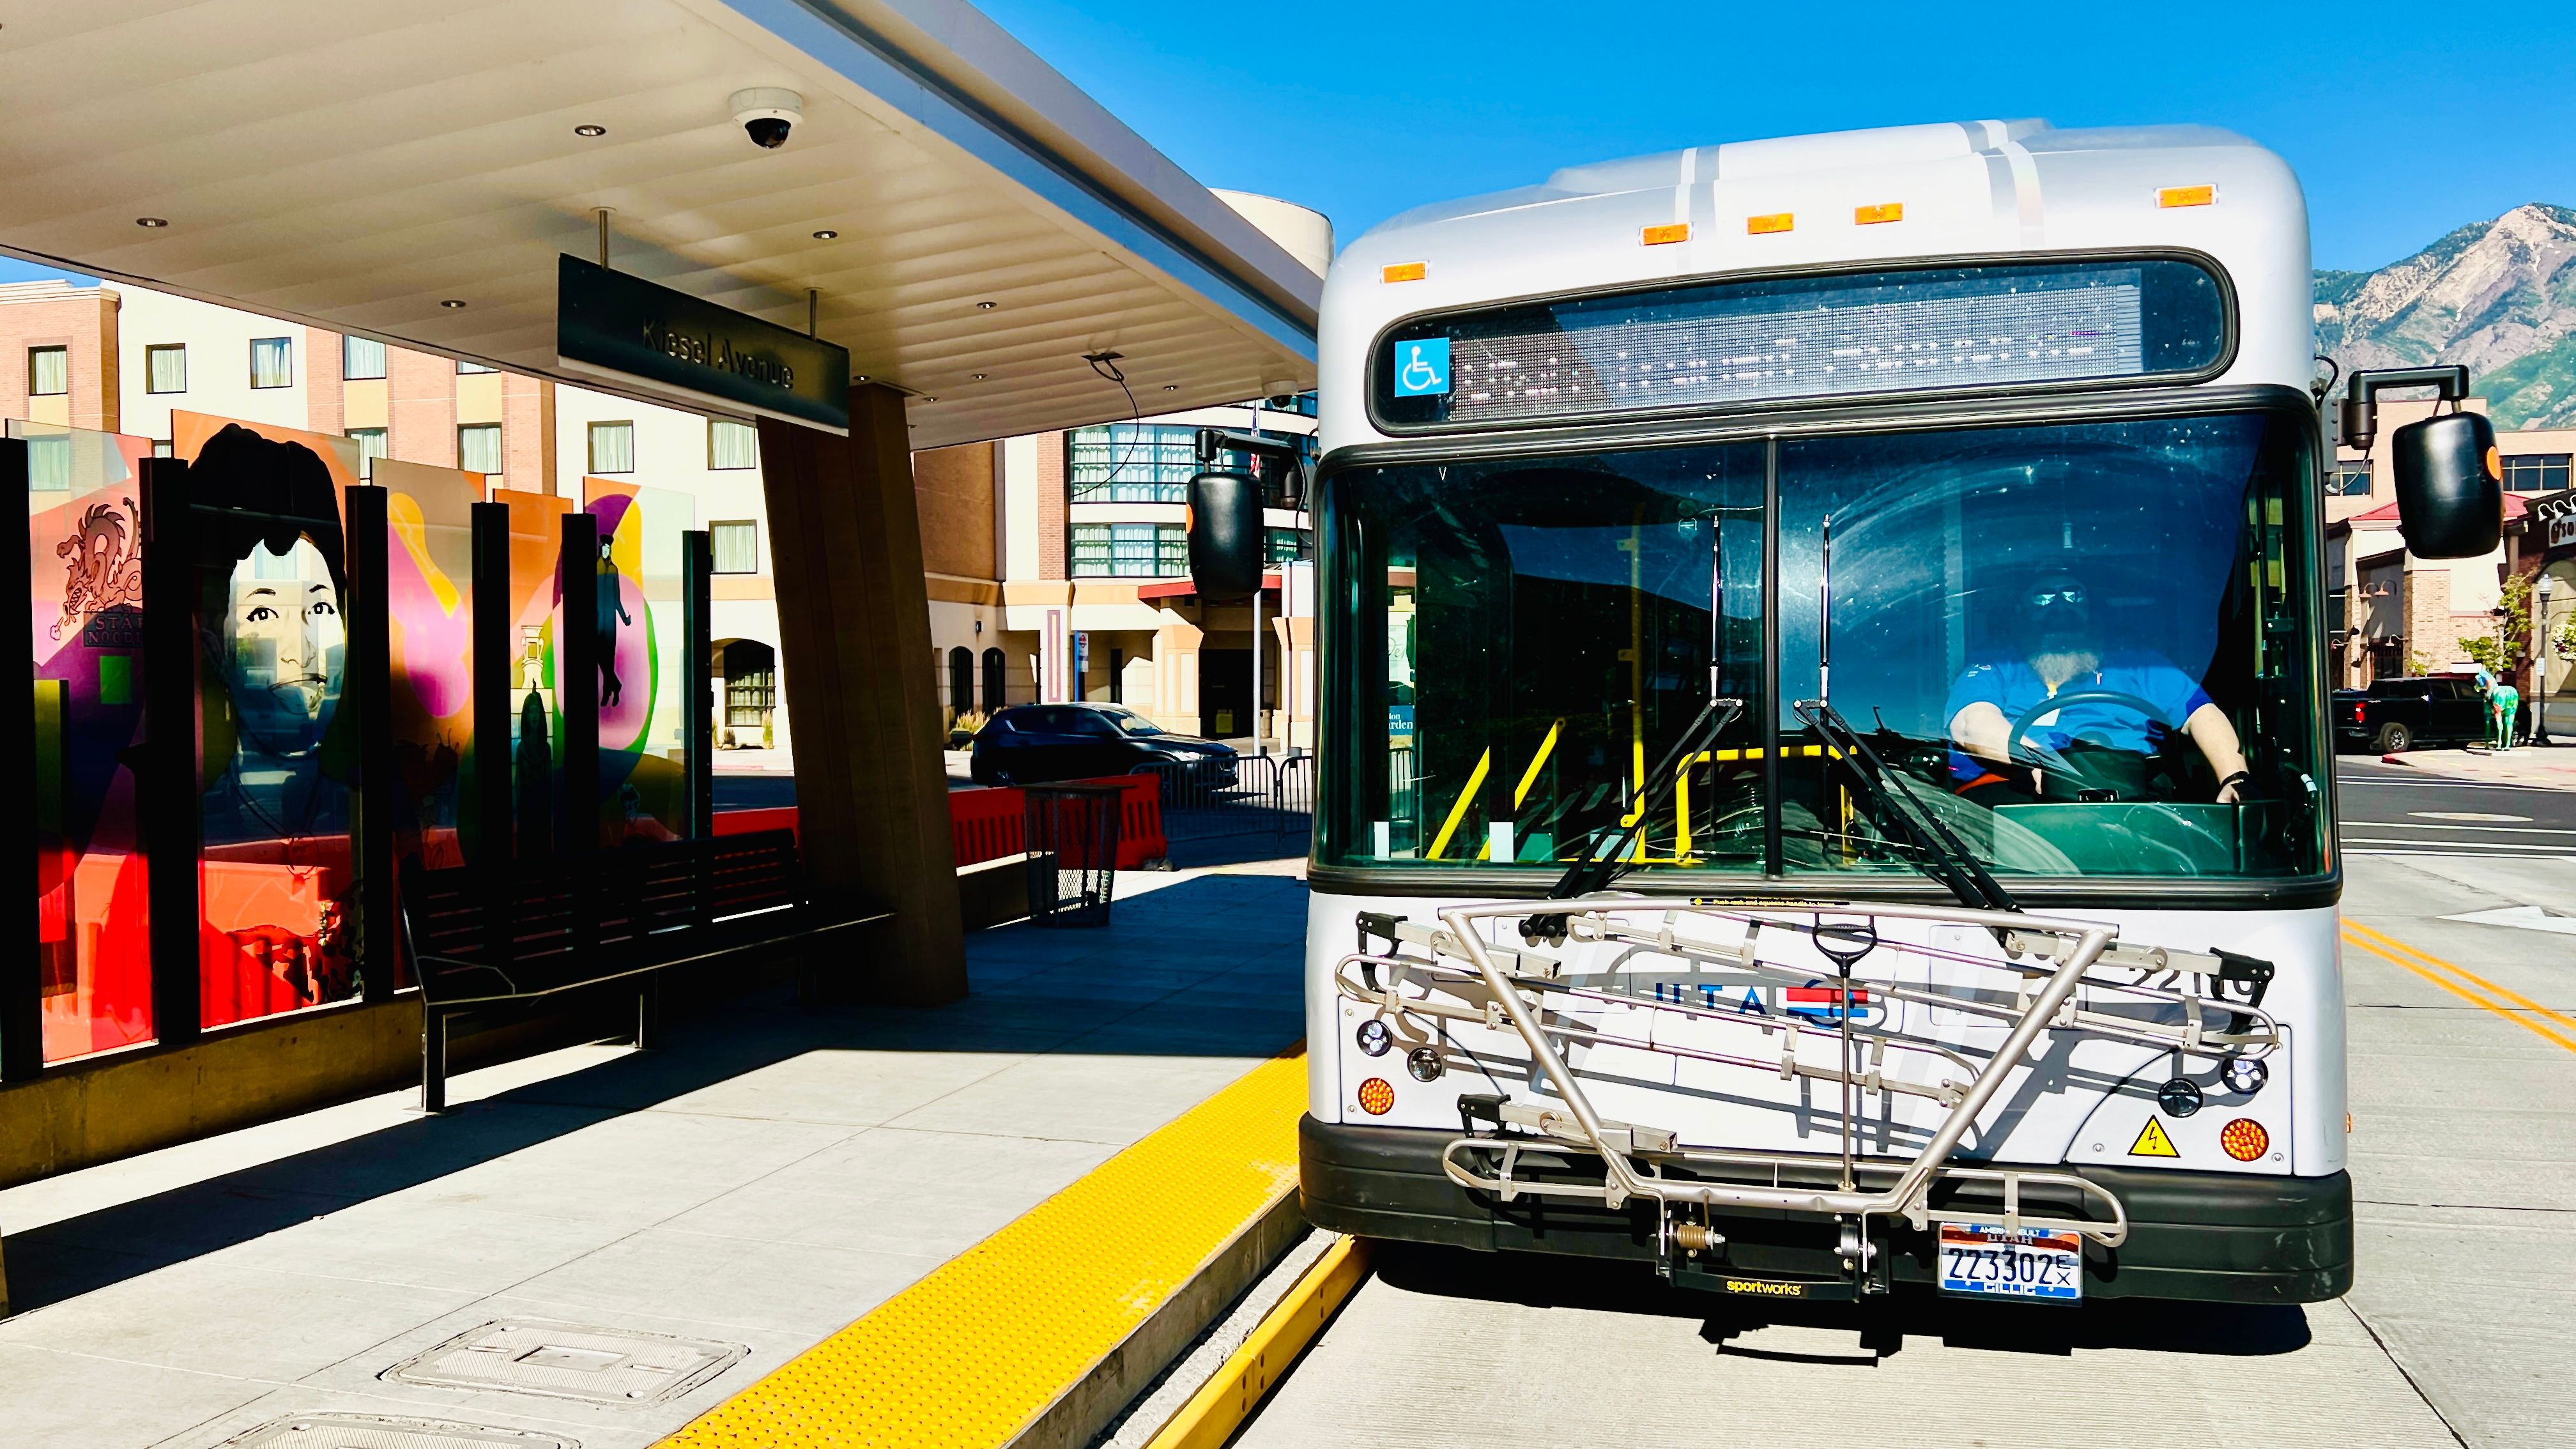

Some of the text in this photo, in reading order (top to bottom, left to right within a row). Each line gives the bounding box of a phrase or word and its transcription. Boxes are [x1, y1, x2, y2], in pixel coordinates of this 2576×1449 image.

[643, 317, 794, 389] Kiesel Avenue
[1656, 983, 1767, 1015] UTA
[1949, 1248, 2053, 1284] 223302
[1727, 1281, 1800, 1295] sportworks
[1984, 1282, 2036, 1296] GILLIG
